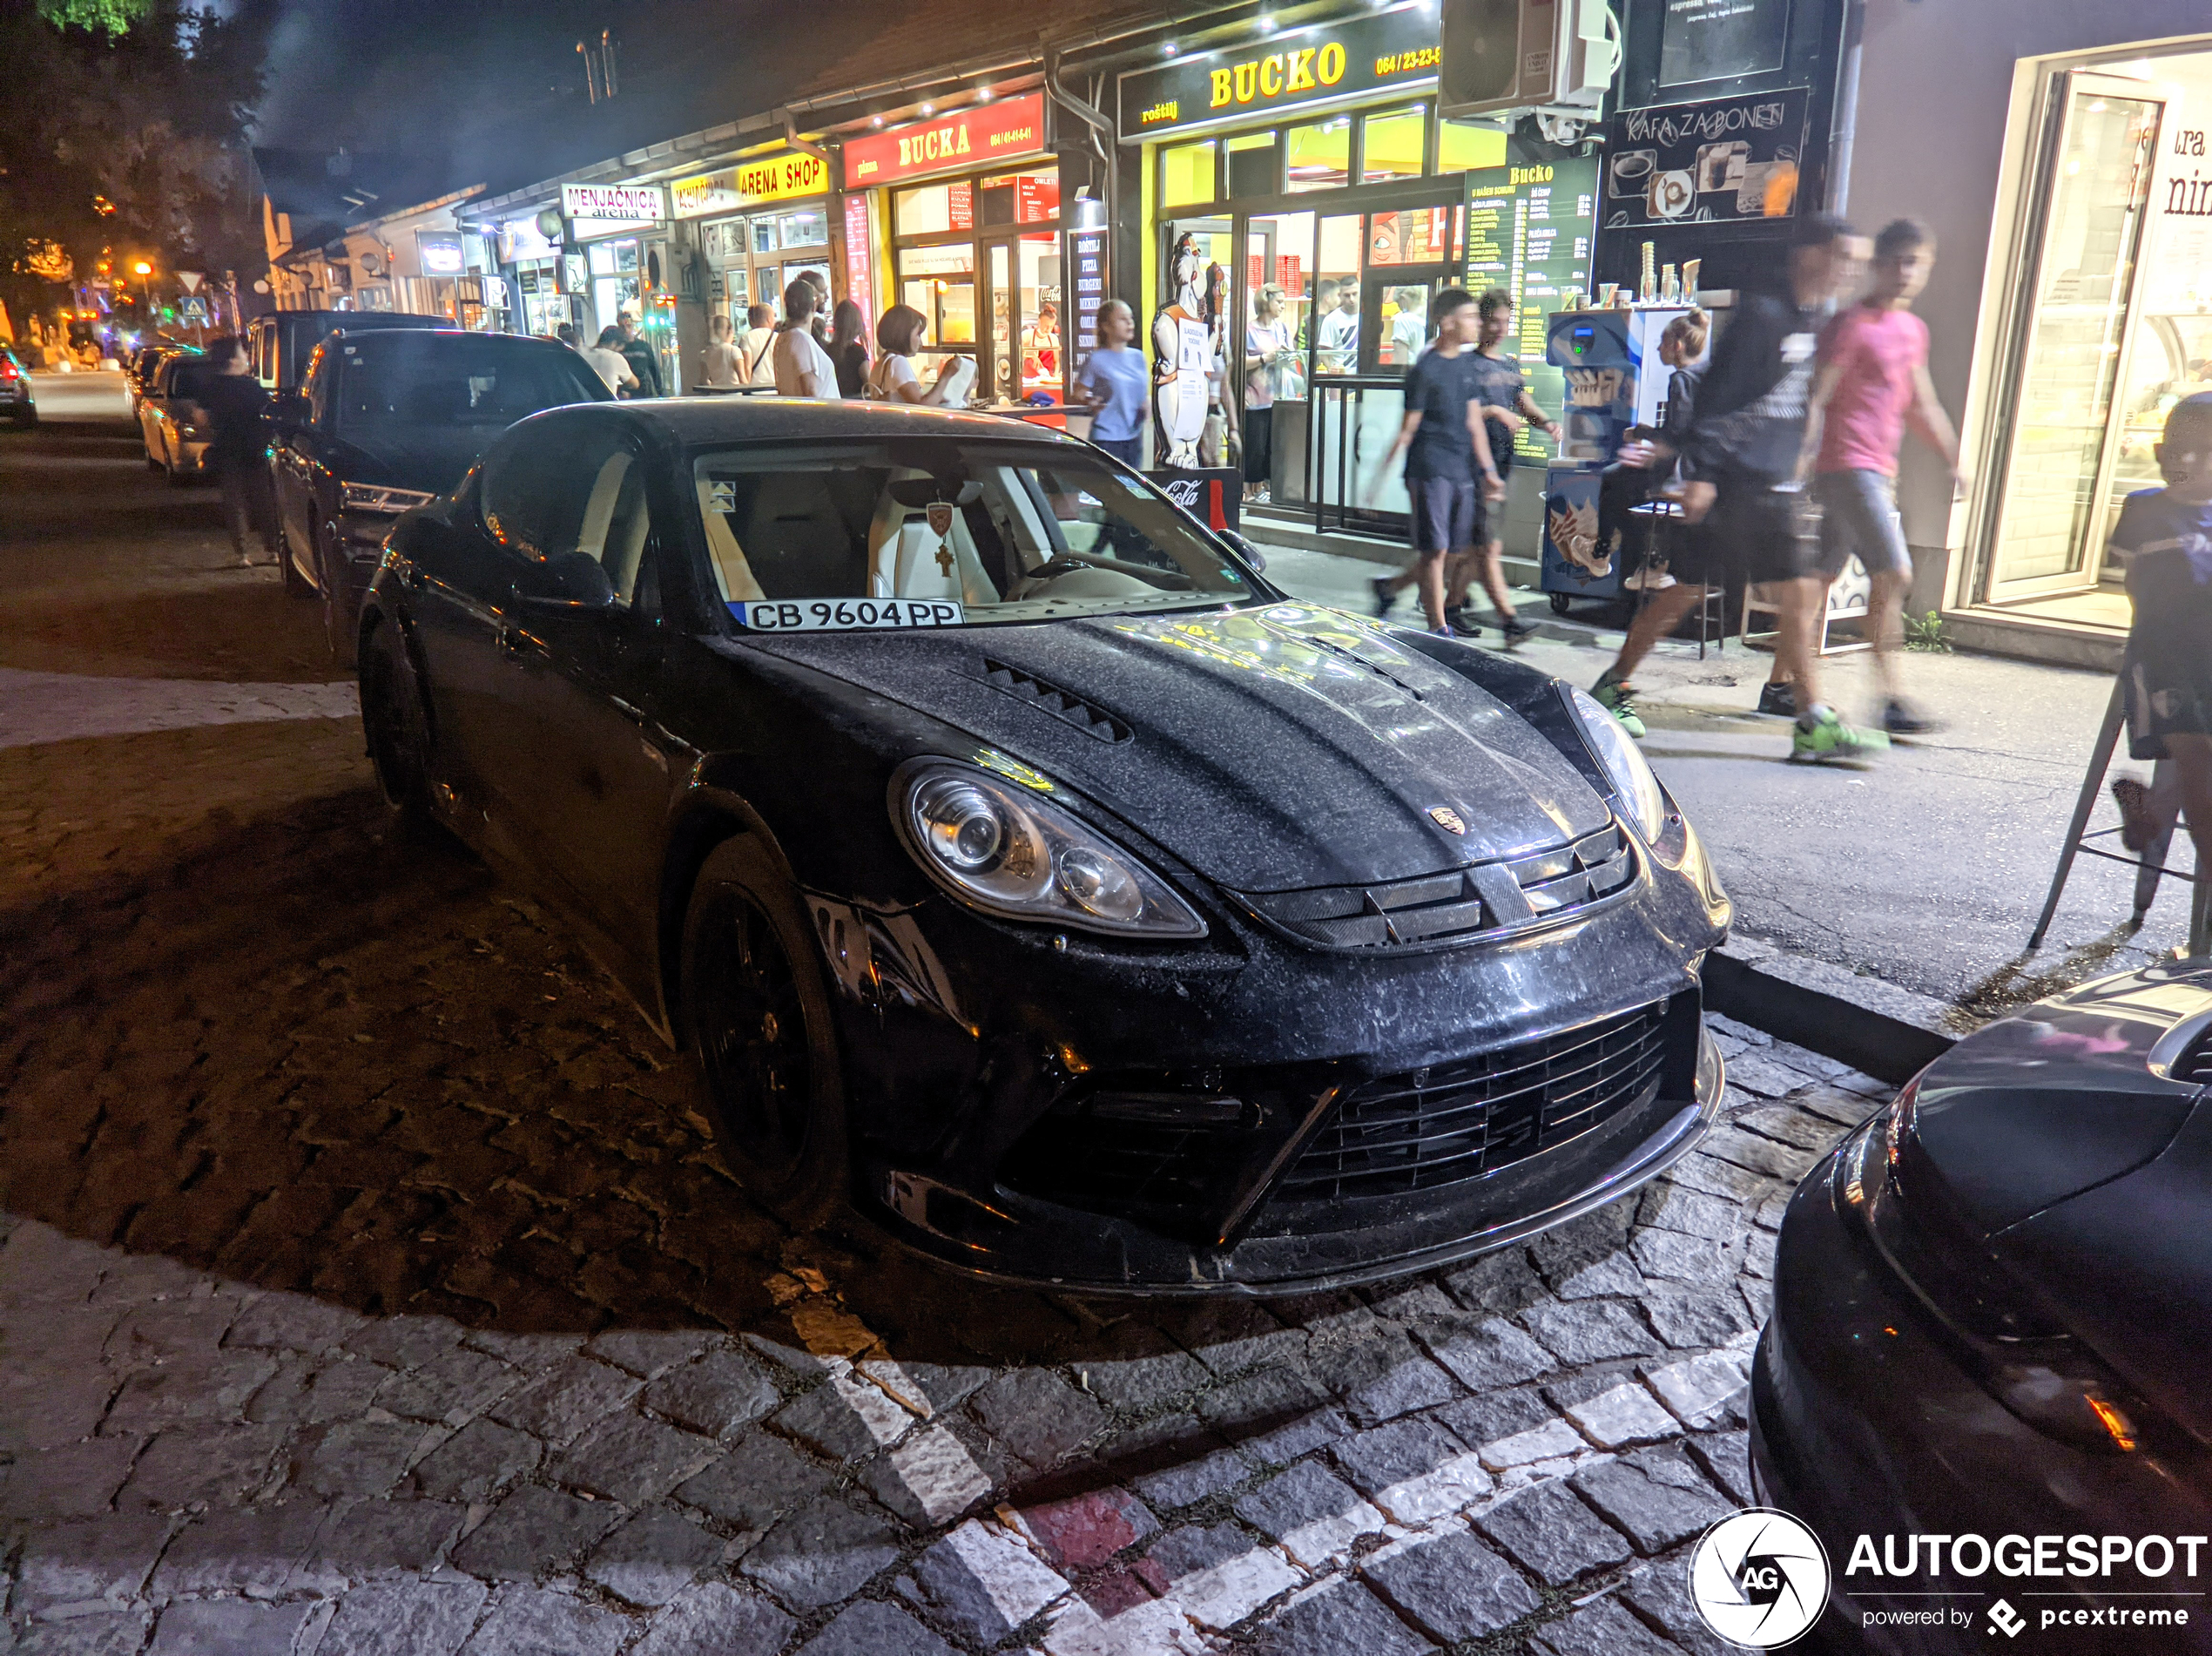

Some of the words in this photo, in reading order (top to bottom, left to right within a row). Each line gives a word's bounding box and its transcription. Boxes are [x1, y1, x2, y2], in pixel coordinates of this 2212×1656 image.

[1210, 41, 1347, 109] BUCKO
[1141, 100, 1178, 124] roštilj
[1628, 116, 1674, 141] KAFA
[1680, 112, 1707, 136] ZA
[1715, 103, 1785, 131] PONETI
[899, 124, 971, 166] BUCKA
[741, 166, 778, 197] ARENA
[786, 159, 819, 189] SHOP
[857, 159, 879, 179] pizza
[1510, 165, 1554, 185] Bucko
[568, 186, 658, 208] MENJAČNICA
[592, 208, 640, 219] arena
[1078, 238, 1100, 253] ROŠTILJ
[1082, 259, 1097, 272] PIZZA
[1078, 278, 1102, 292] BURGERI
[752, 604, 803, 629] CB
[810, 602, 901, 625] 9604
[907, 602, 956, 626] PP
